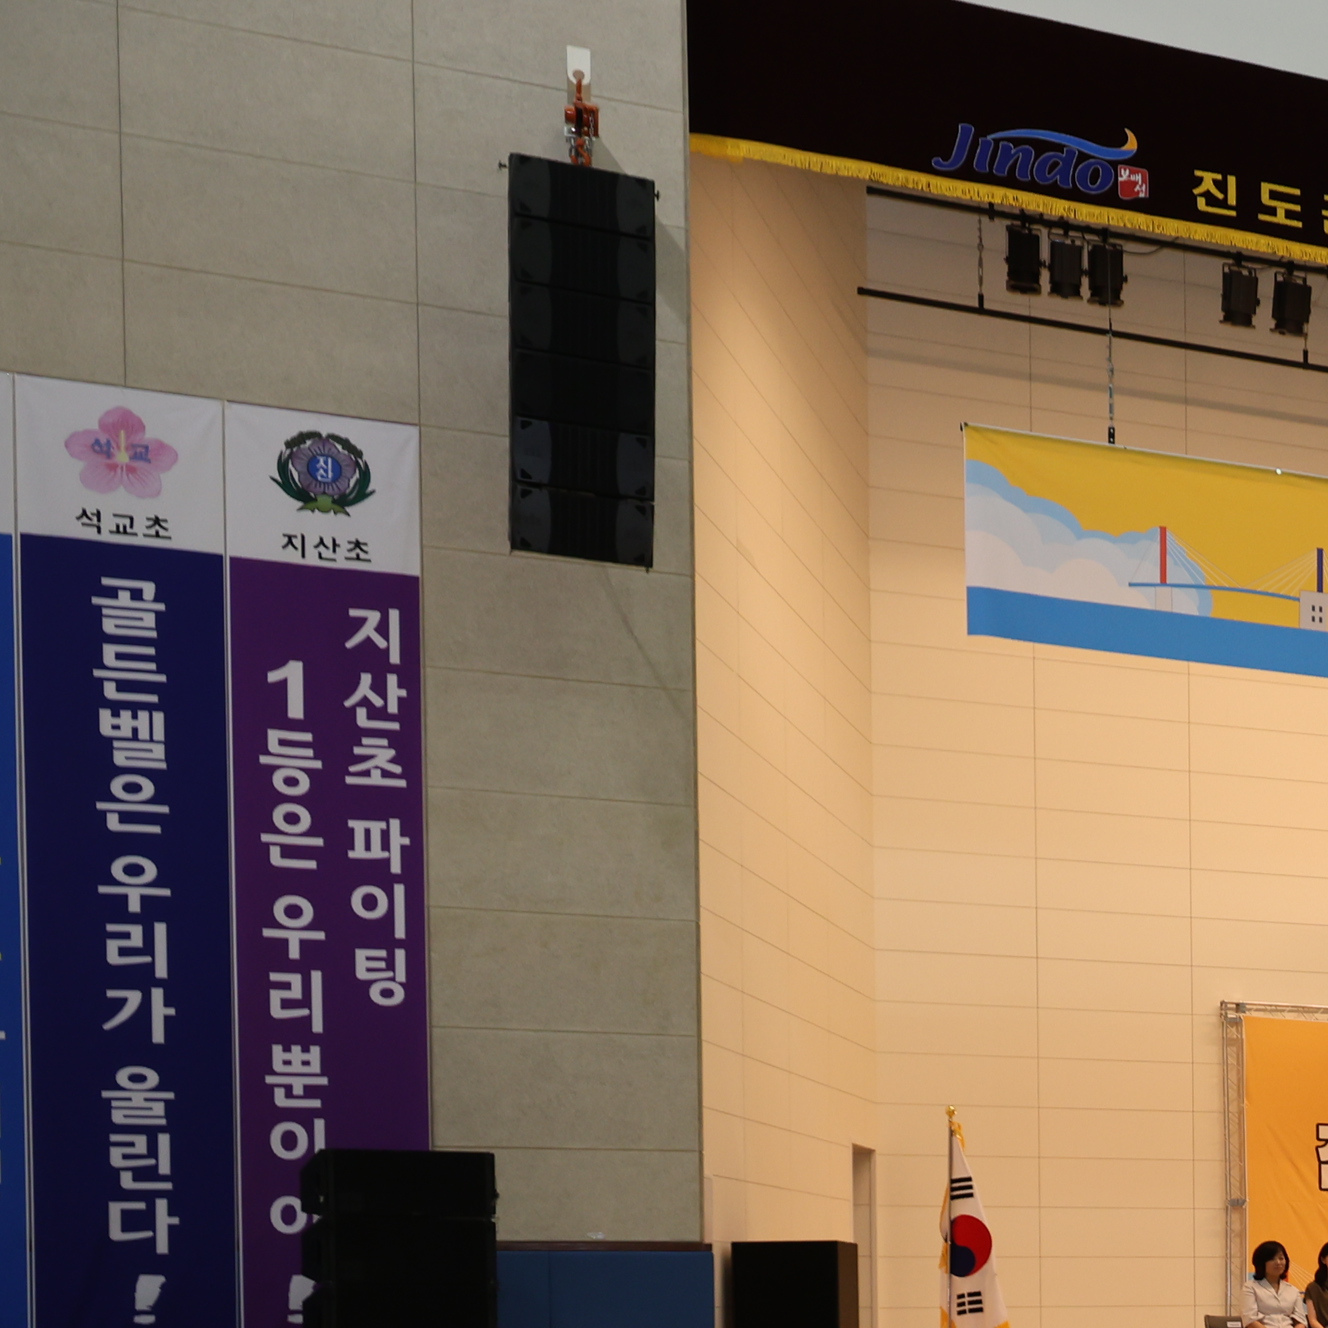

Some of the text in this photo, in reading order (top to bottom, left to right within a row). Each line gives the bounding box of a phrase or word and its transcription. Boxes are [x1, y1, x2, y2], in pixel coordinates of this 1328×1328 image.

[932, 123, 1115, 194] Jindo
[75, 507, 172, 540] 석교초
[282, 533, 372, 562] 지산초
[91, 576, 170, 834] 골든벨은
[259, 660, 324, 869] 1등은
[343, 608, 411, 1006] 지산초 파이팅
[97, 855, 176, 1044] 우리가
